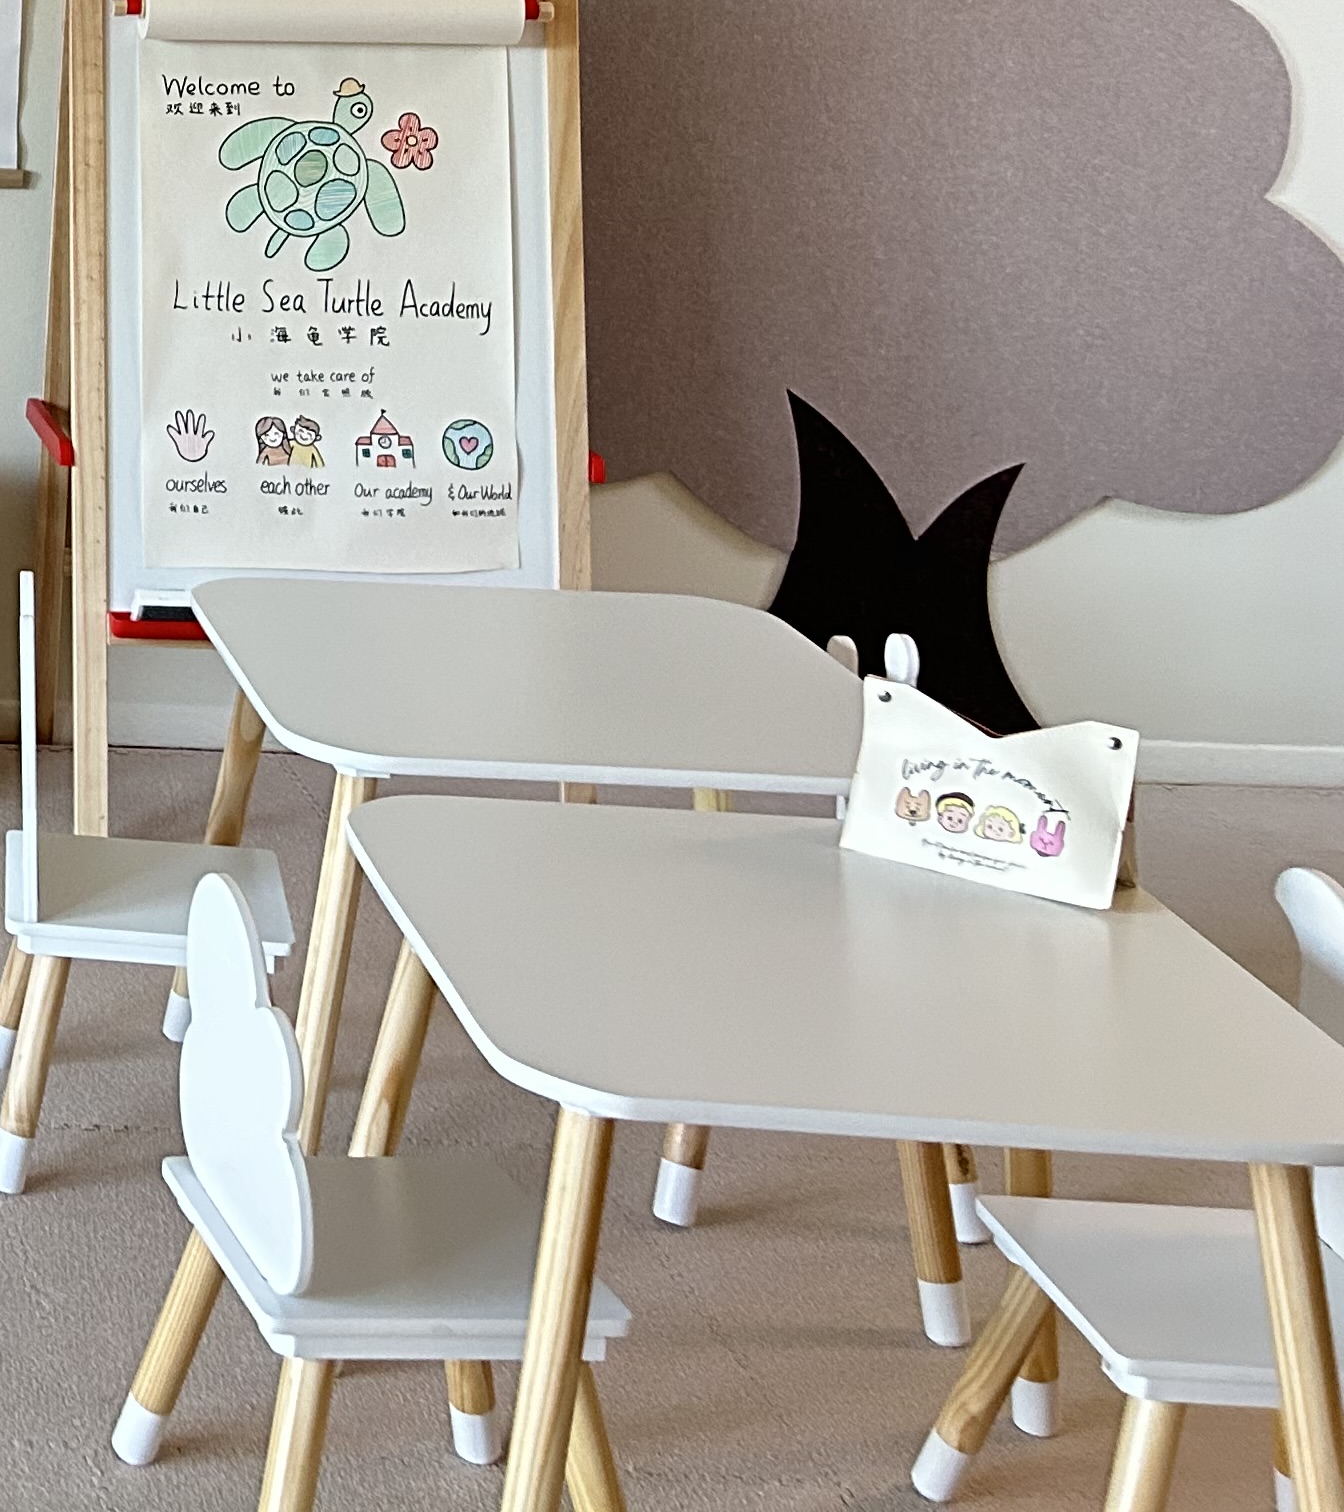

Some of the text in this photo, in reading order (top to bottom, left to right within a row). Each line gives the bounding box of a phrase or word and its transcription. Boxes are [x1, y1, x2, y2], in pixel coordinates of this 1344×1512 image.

[161, 74, 295, 99] Welcome to
[165, 101, 241, 117] 欢迎来到
[173, 277, 492, 336] Little Sea Turtle Academy
[270, 366, 376, 385] we take care of
[165, 470, 228, 494] ourselves
[259, 475, 331, 496] each other
[457, 484, 480, 500] Our
[480, 481, 513, 501] World
[353, 480, 433, 507] Our academy
